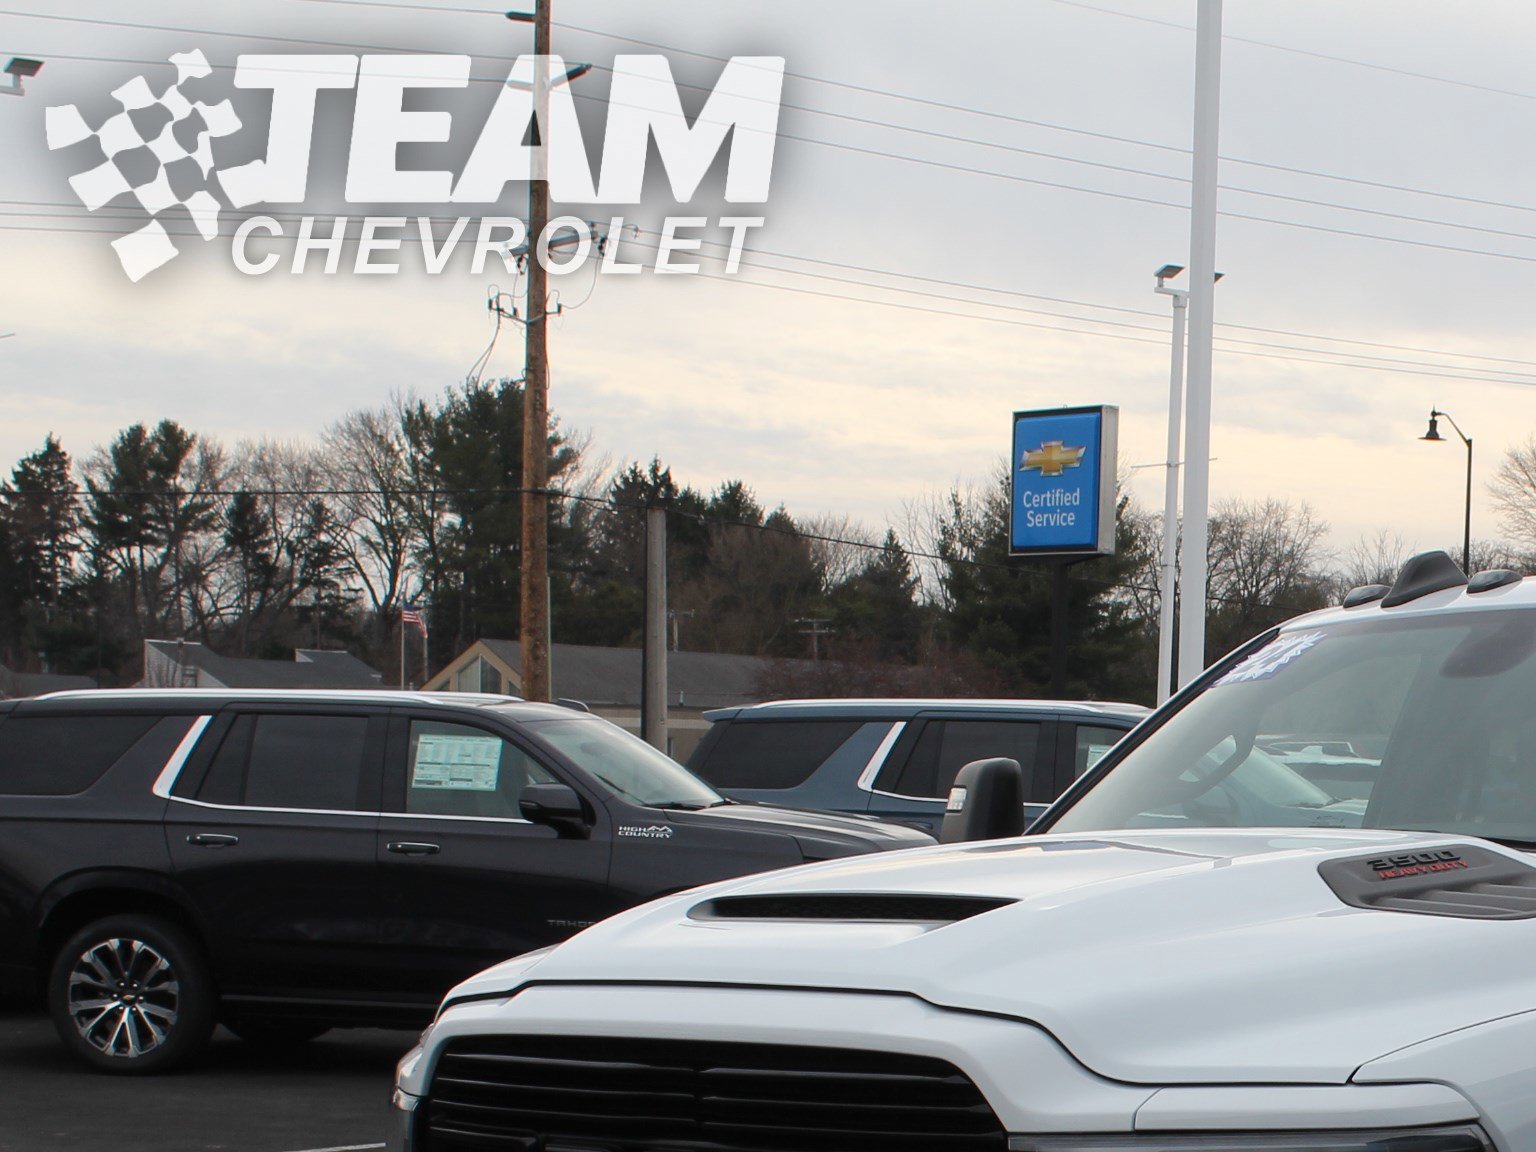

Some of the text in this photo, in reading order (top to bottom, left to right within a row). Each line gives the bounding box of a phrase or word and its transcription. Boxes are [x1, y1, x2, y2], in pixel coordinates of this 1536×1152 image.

[1023, 488, 1080, 508] Certified
[1026, 510, 1075, 527] Service
[618, 831, 671, 839] COUNTRY
[1377, 860, 1469, 880] HEAVY DUTY
